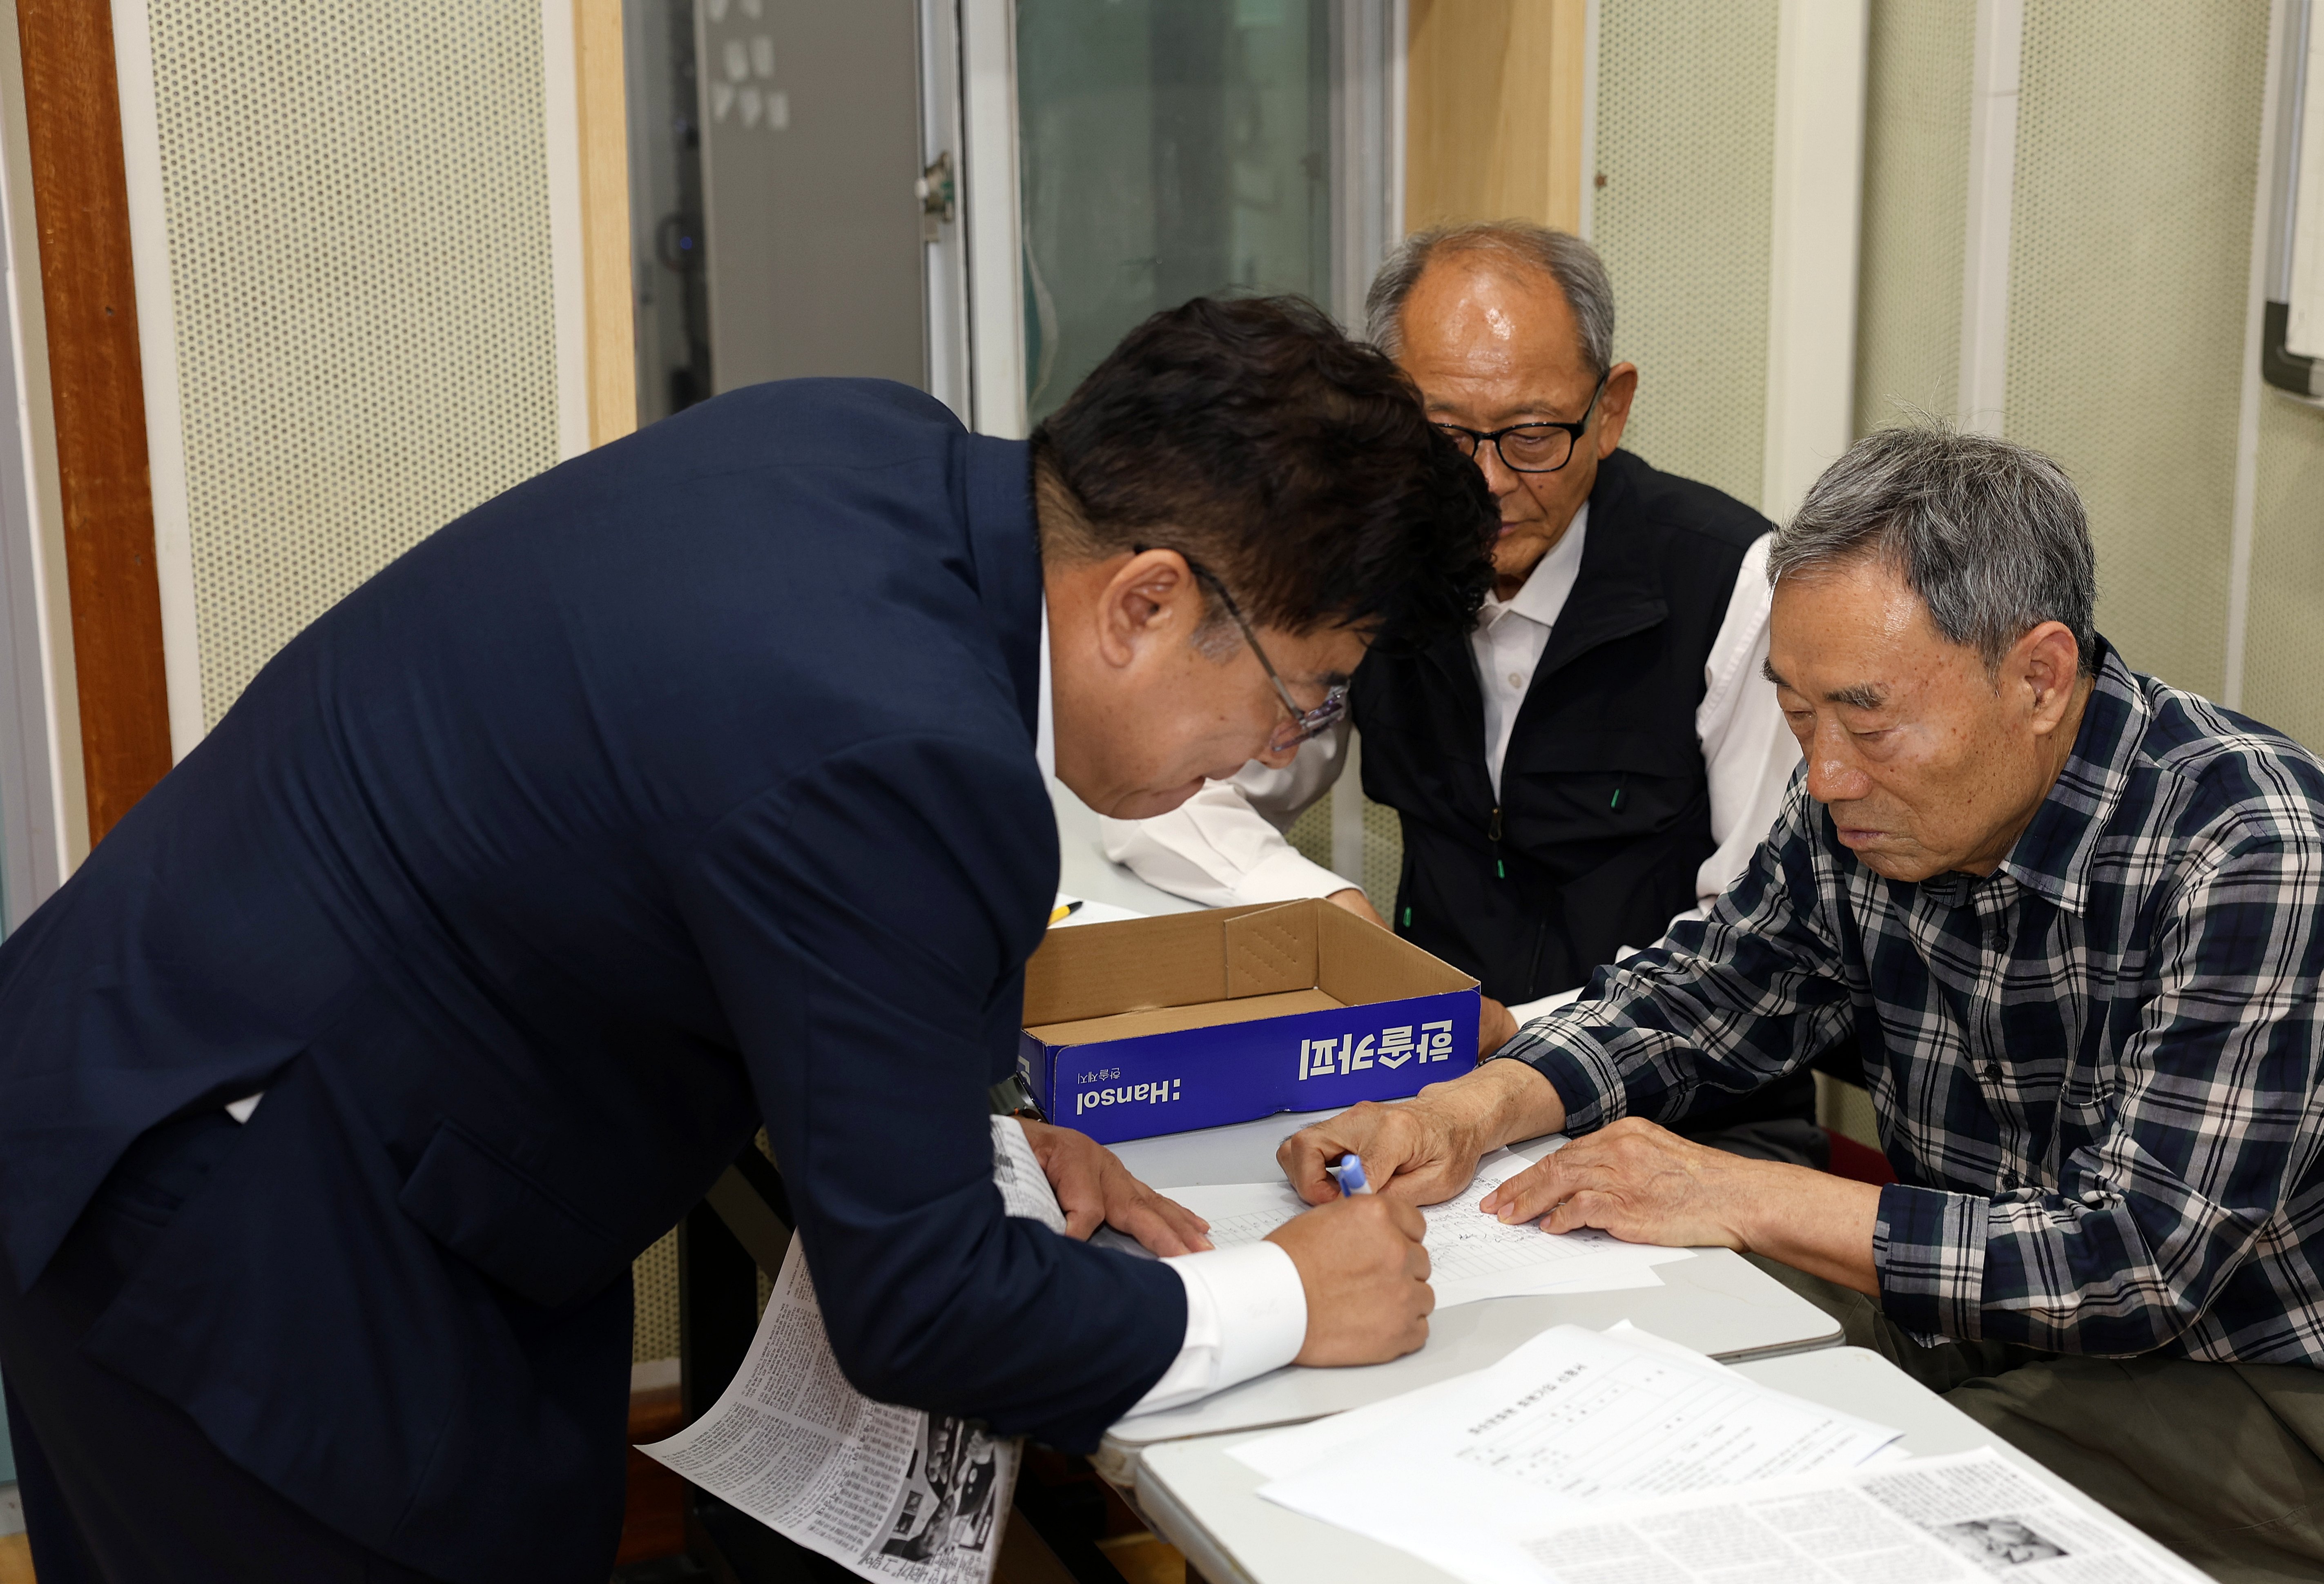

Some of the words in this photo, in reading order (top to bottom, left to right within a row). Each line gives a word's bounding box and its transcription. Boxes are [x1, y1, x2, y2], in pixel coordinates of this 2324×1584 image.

[1299, 1020, 1453, 1081] 한솔카피
[1078, 1067, 1120, 1084] 한솔제지
[1077, 1081, 1169, 1115] Hansol
